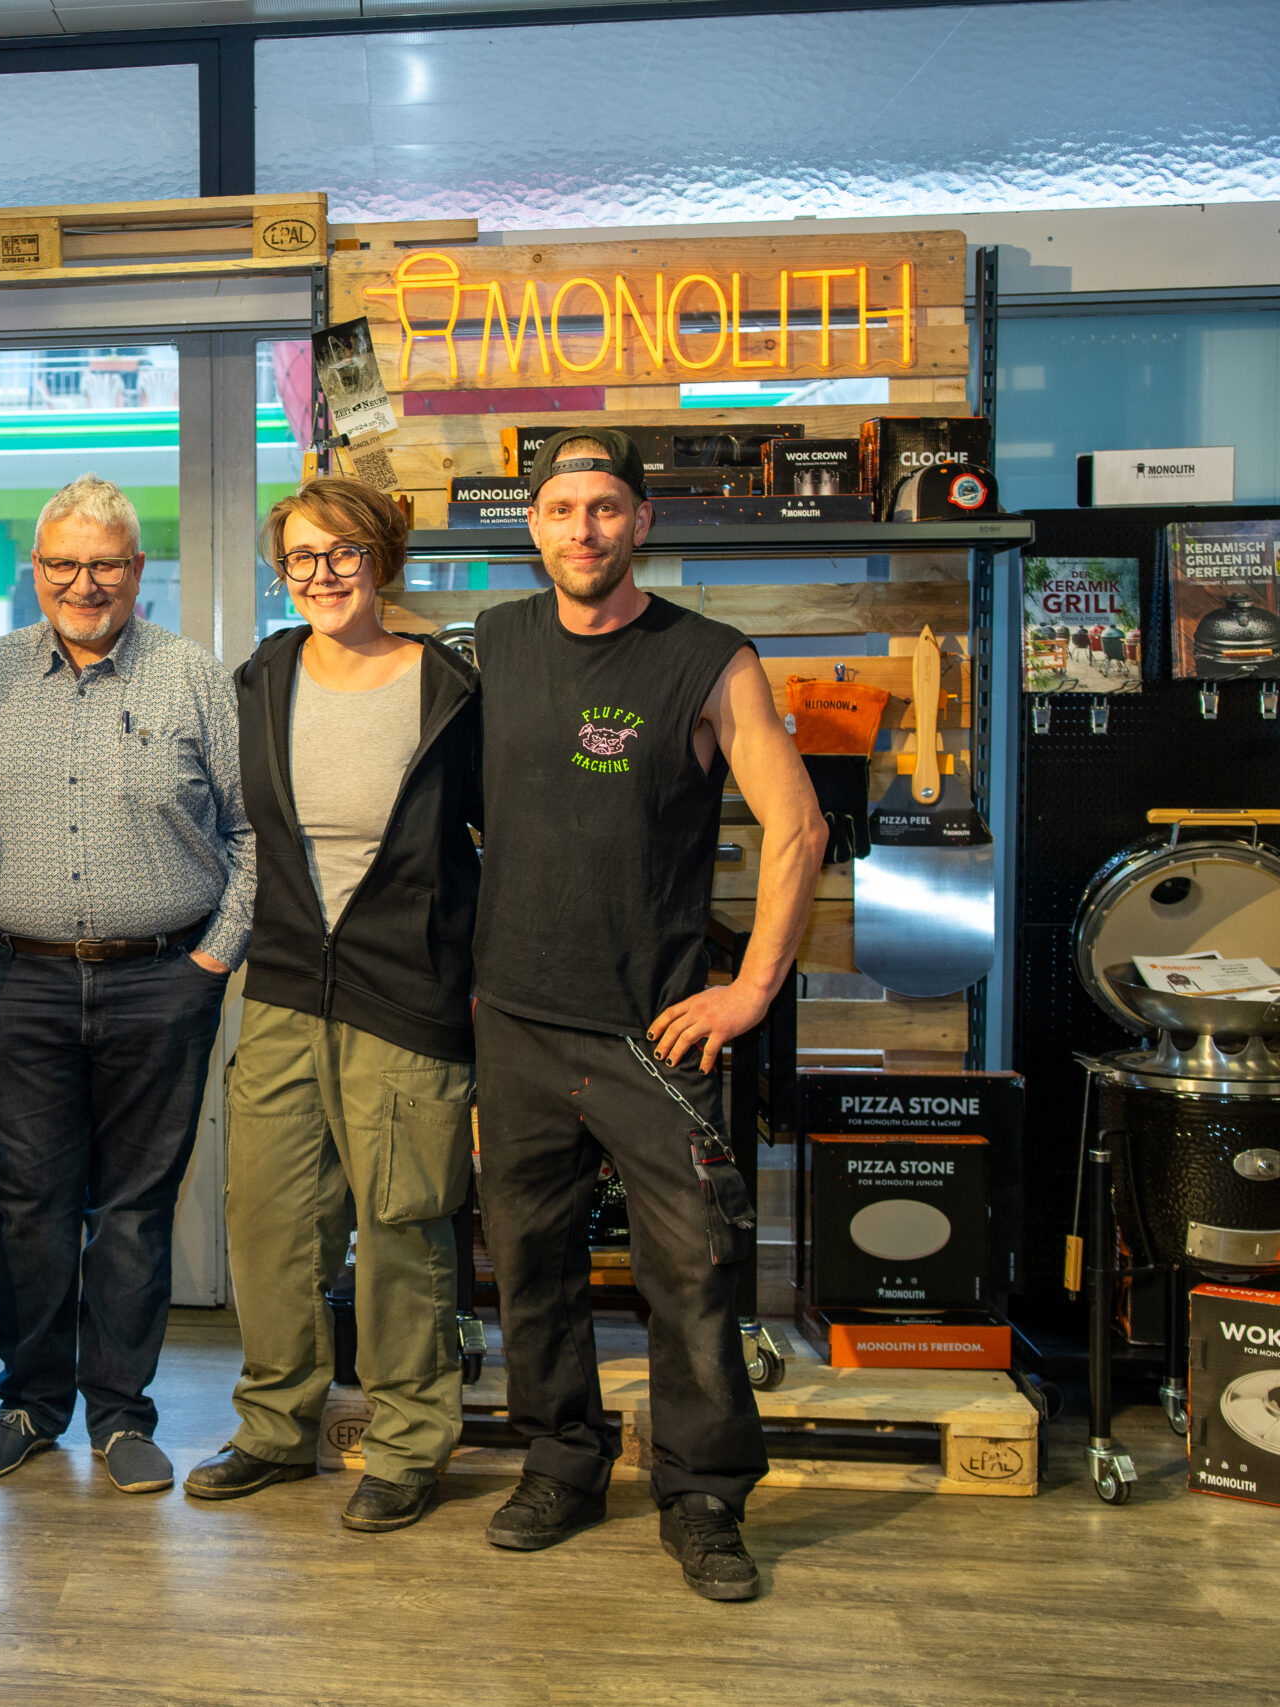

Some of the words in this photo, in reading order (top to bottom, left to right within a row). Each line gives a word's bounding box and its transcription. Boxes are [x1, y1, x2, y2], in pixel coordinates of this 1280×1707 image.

[271, 226, 309, 244] EPAL
[477, 260, 915, 378] MONOLITH
[347, 436, 381, 452] MONOLITH
[785, 452, 810, 461] WOK
[811, 451, 848, 461] CROWN
[900, 451, 969, 467] CLOCHE
[1148, 464, 1195, 475] MONOLITH
[787, 509, 820, 518] MONOLITH
[1185, 541, 1266, 554] KERAMISCH
[1185, 554, 1242, 566] GRILLEN
[1245, 553, 1260, 564] IN
[1071, 571, 1091, 579] DER
[1186, 565, 1273, 578] PERFEKTION
[1043, 580, 1121, 593] KERAMIK
[1042, 593, 1123, 614] GRILL
[805, 699, 851, 711] MONOLITH
[581, 706, 645, 729] FLUFFY
[880, 816, 909, 825] PIZZA
[910, 816, 931, 825] PEEL
[841, 1095, 905, 1115] PIZZA
[908, 1096, 980, 1116] STONE
[848, 1118, 863, 1126] FOR
[864, 1119, 901, 1127] MONOLITH
[902, 1119, 930, 1127] CLASSIC
[931, 1119, 936, 1127] &
[848, 1160, 897, 1174] PIZZA
[900, 1160, 955, 1175] STONE
[874, 1179, 914, 1187] MONOLITH
[884, 1289, 925, 1300] MONOLITH
[1205, 1286, 1276, 1299] KAMADO
[1220, 1321, 1280, 1347] WOK
[856, 1342, 916, 1352] MONOLITH
[918, 1342, 928, 1352] IS
[930, 1342, 985, 1353] FREEDOM.
[1244, 1346, 1258, 1355] FOR
[1207, 1474, 1257, 1493] MONOLITH
